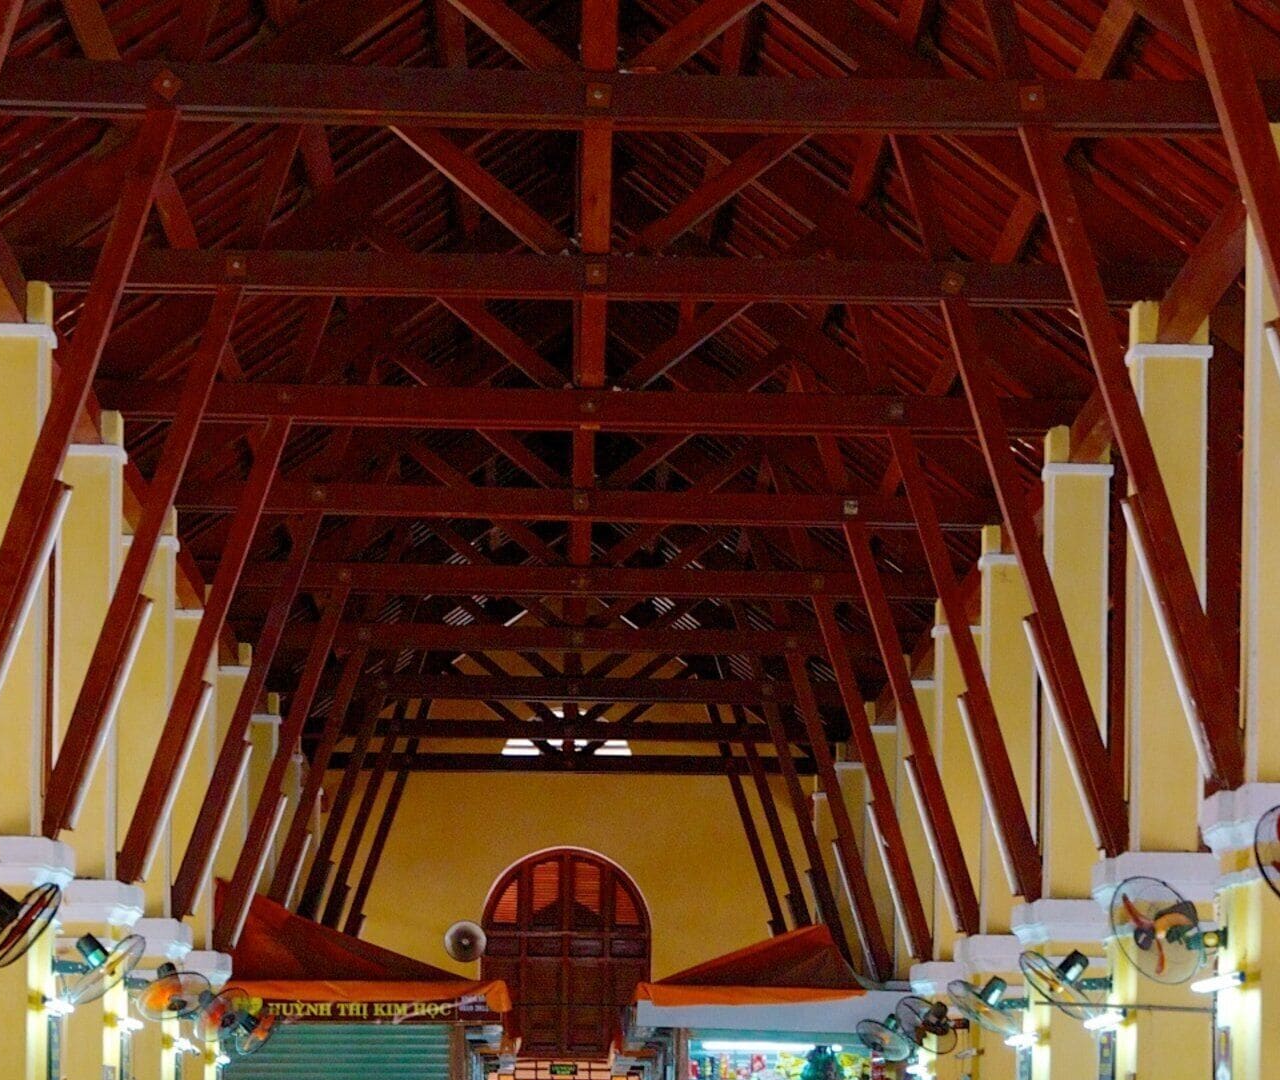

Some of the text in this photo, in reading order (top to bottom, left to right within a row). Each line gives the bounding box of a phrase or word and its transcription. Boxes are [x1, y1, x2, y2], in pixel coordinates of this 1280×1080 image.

[270, 1000, 332, 1017] HUỲNH
[336, 1002, 368, 1020] THỊ
[373, 1002, 408, 1017] KIM
[412, 1002, 452, 1020] HỌC
